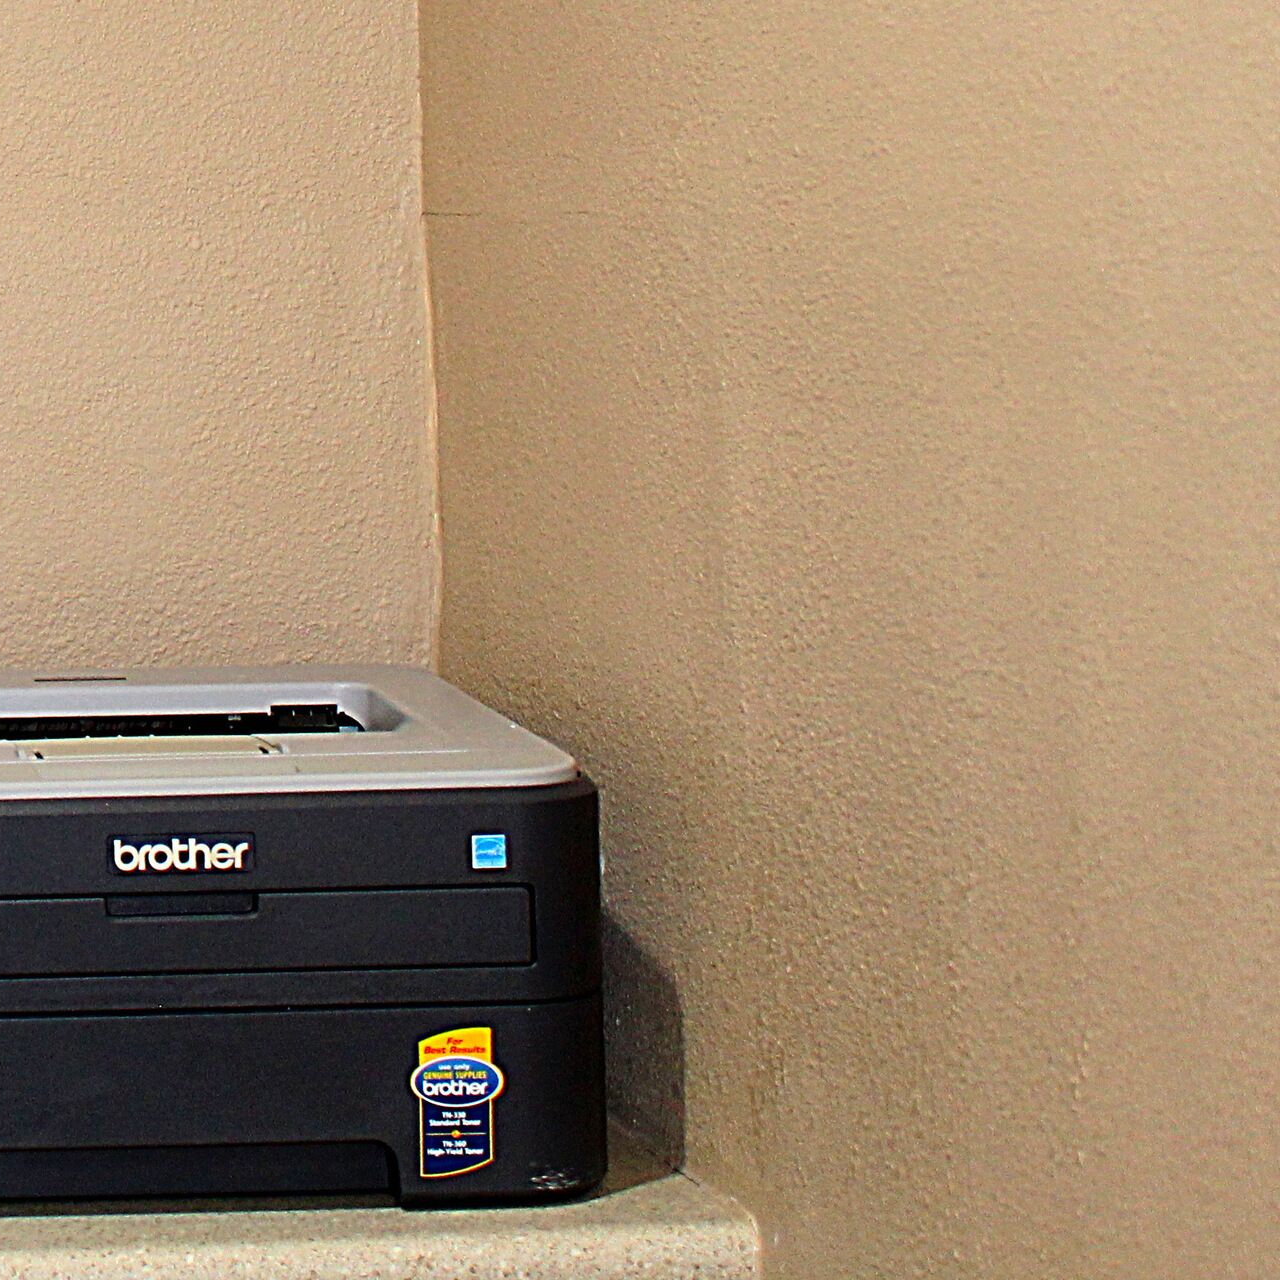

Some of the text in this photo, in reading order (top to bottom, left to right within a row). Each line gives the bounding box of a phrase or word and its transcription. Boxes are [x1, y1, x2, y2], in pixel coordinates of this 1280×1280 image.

[113, 838, 249, 872] brother
[447, 1037, 464, 1045] For
[424, 1046, 486, 1054] Best Results
[423, 1070, 488, 1080] GENUINE SUPPLIES
[422, 1079, 488, 1096] brother
[429, 1118, 481, 1127] Standard Toner
[465, 1147, 484, 1155] Toner
